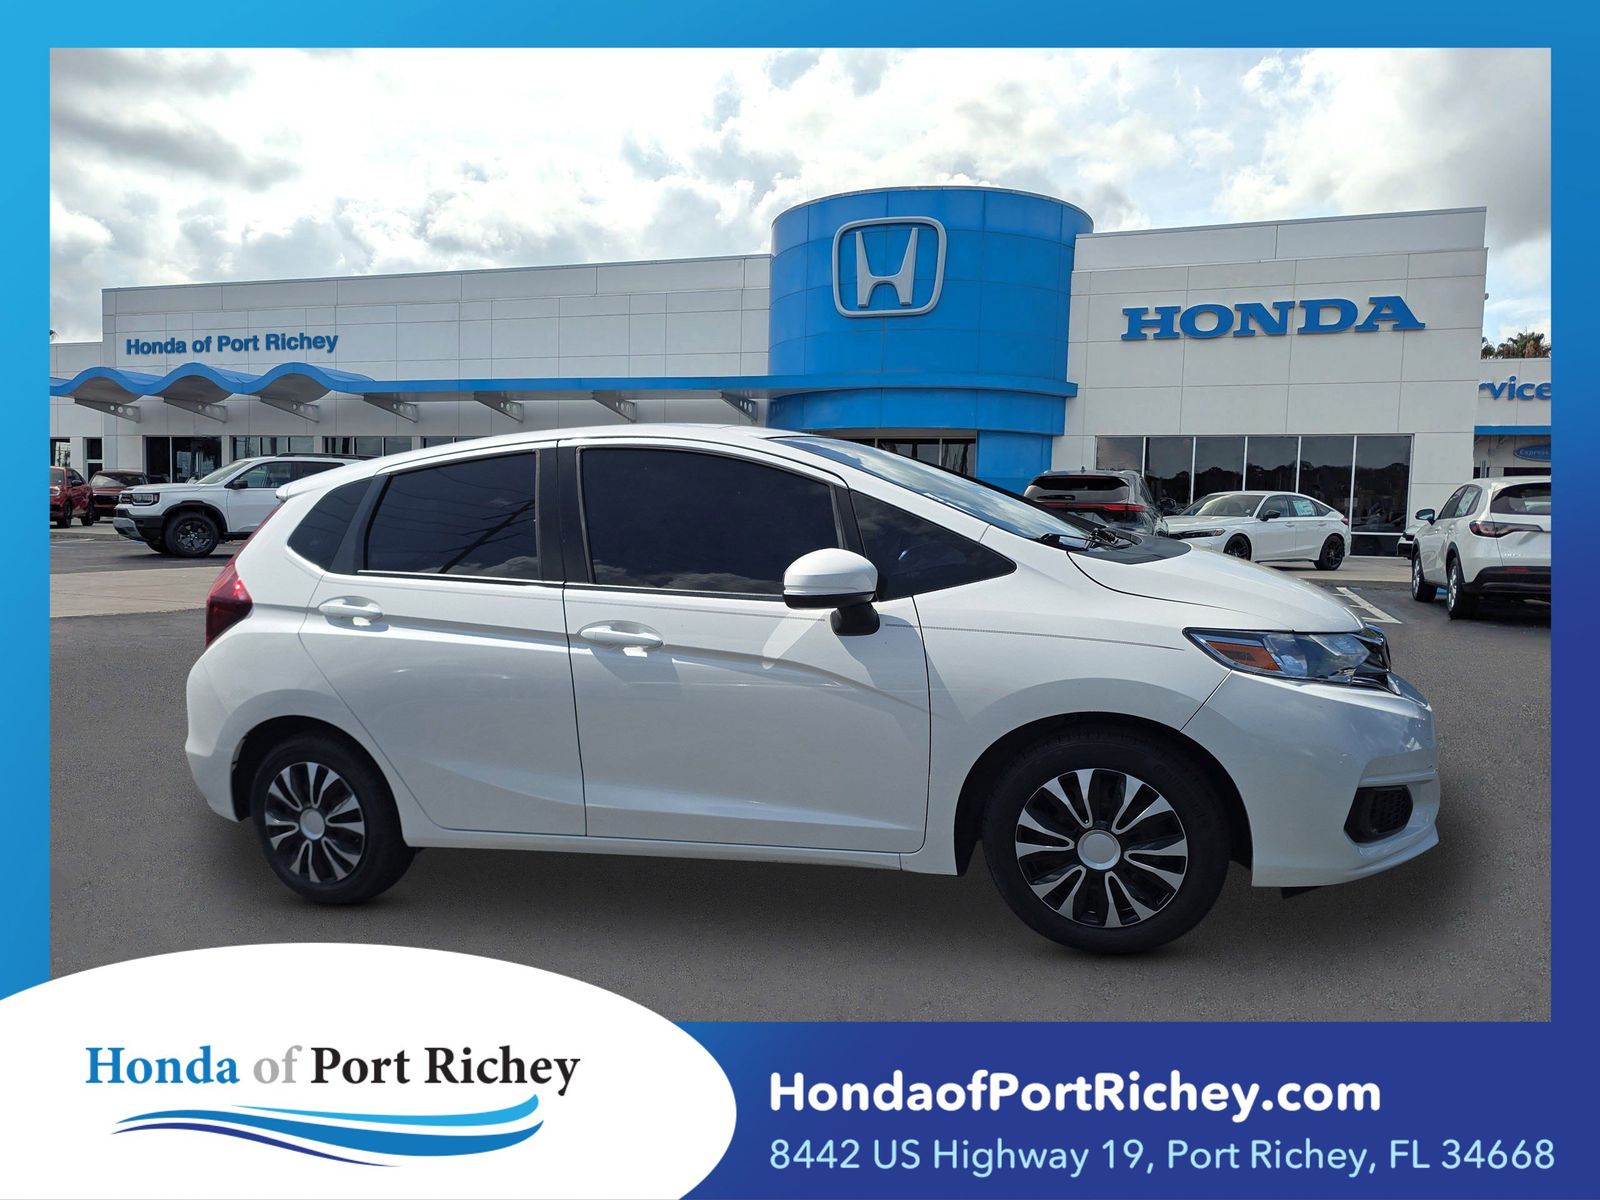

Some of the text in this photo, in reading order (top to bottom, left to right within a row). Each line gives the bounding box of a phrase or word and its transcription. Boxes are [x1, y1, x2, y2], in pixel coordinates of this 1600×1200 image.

[1121, 295, 1426, 341] HONDA
[126, 332, 339, 355] Honda of Port Richey
